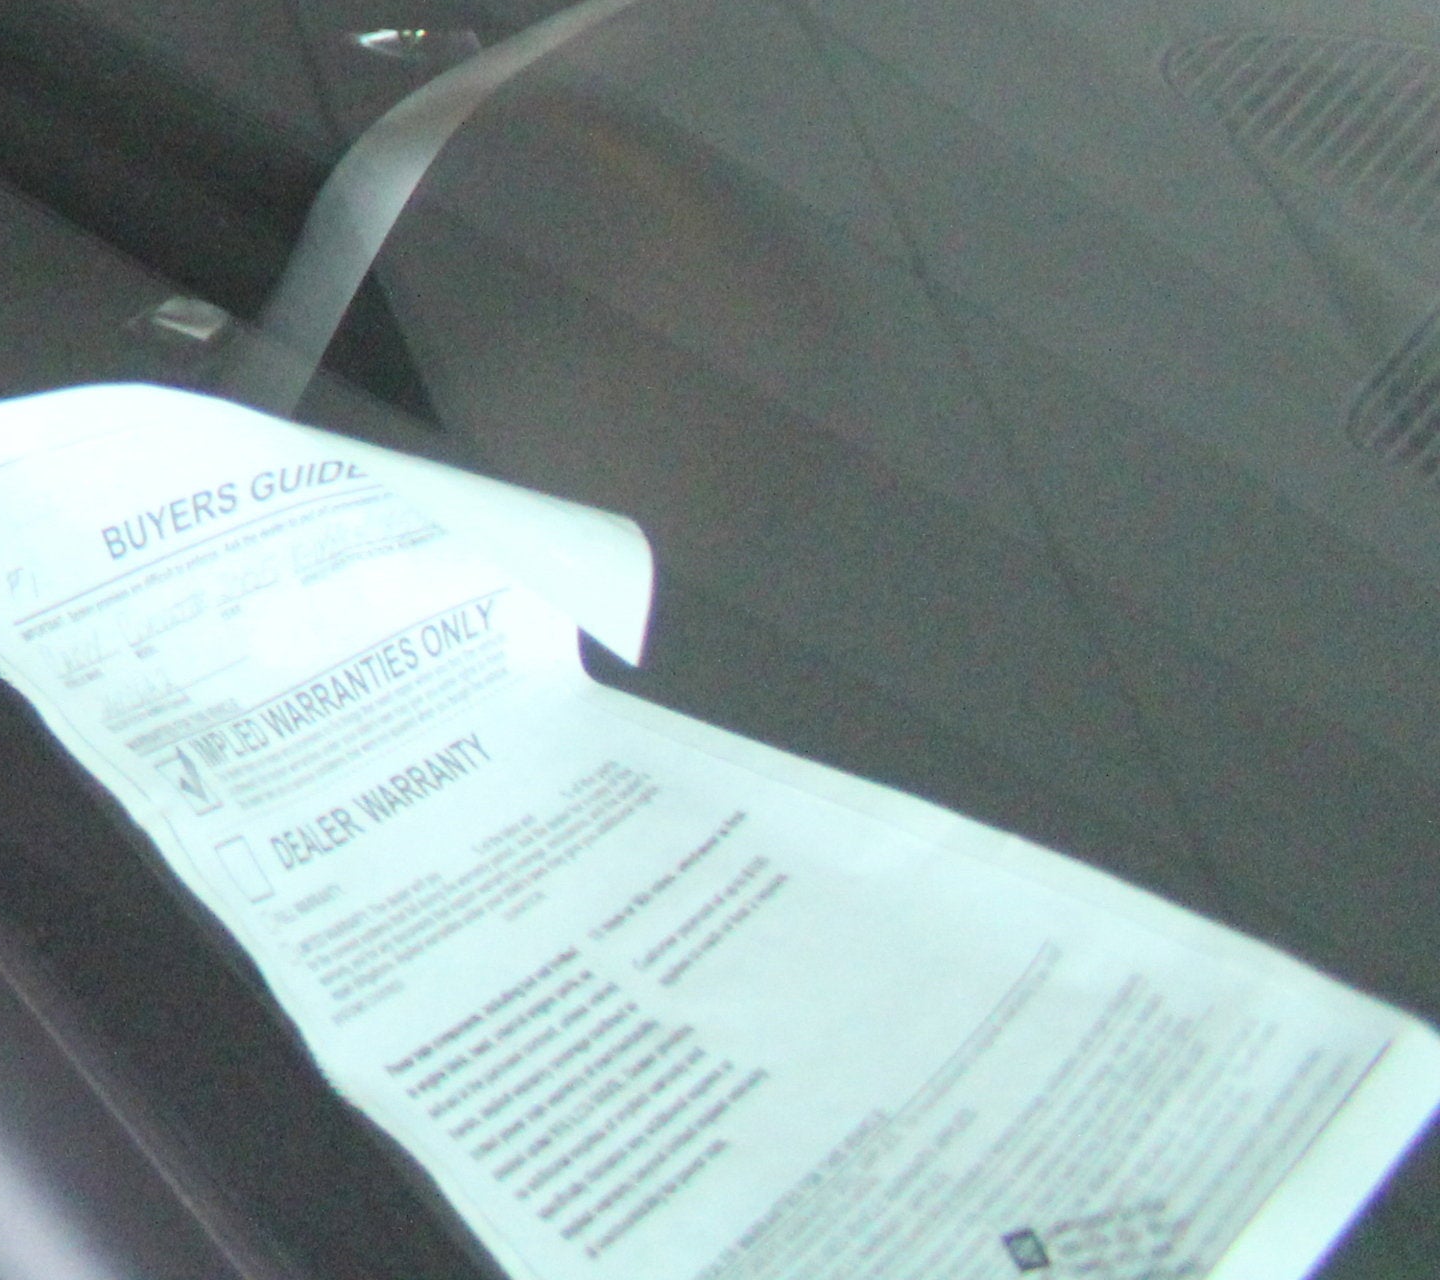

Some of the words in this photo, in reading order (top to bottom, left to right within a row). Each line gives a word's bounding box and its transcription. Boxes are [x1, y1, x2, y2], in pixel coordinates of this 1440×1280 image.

[101, 483, 238, 561] BUYERS
[189, 718, 270, 767] IMPLIED
[261, 637, 419, 739] WARRANTIES
[421, 599, 494, 658] ONLY
[271, 807, 366, 871] DEALER
[353, 731, 491, 823] WARRANTY
